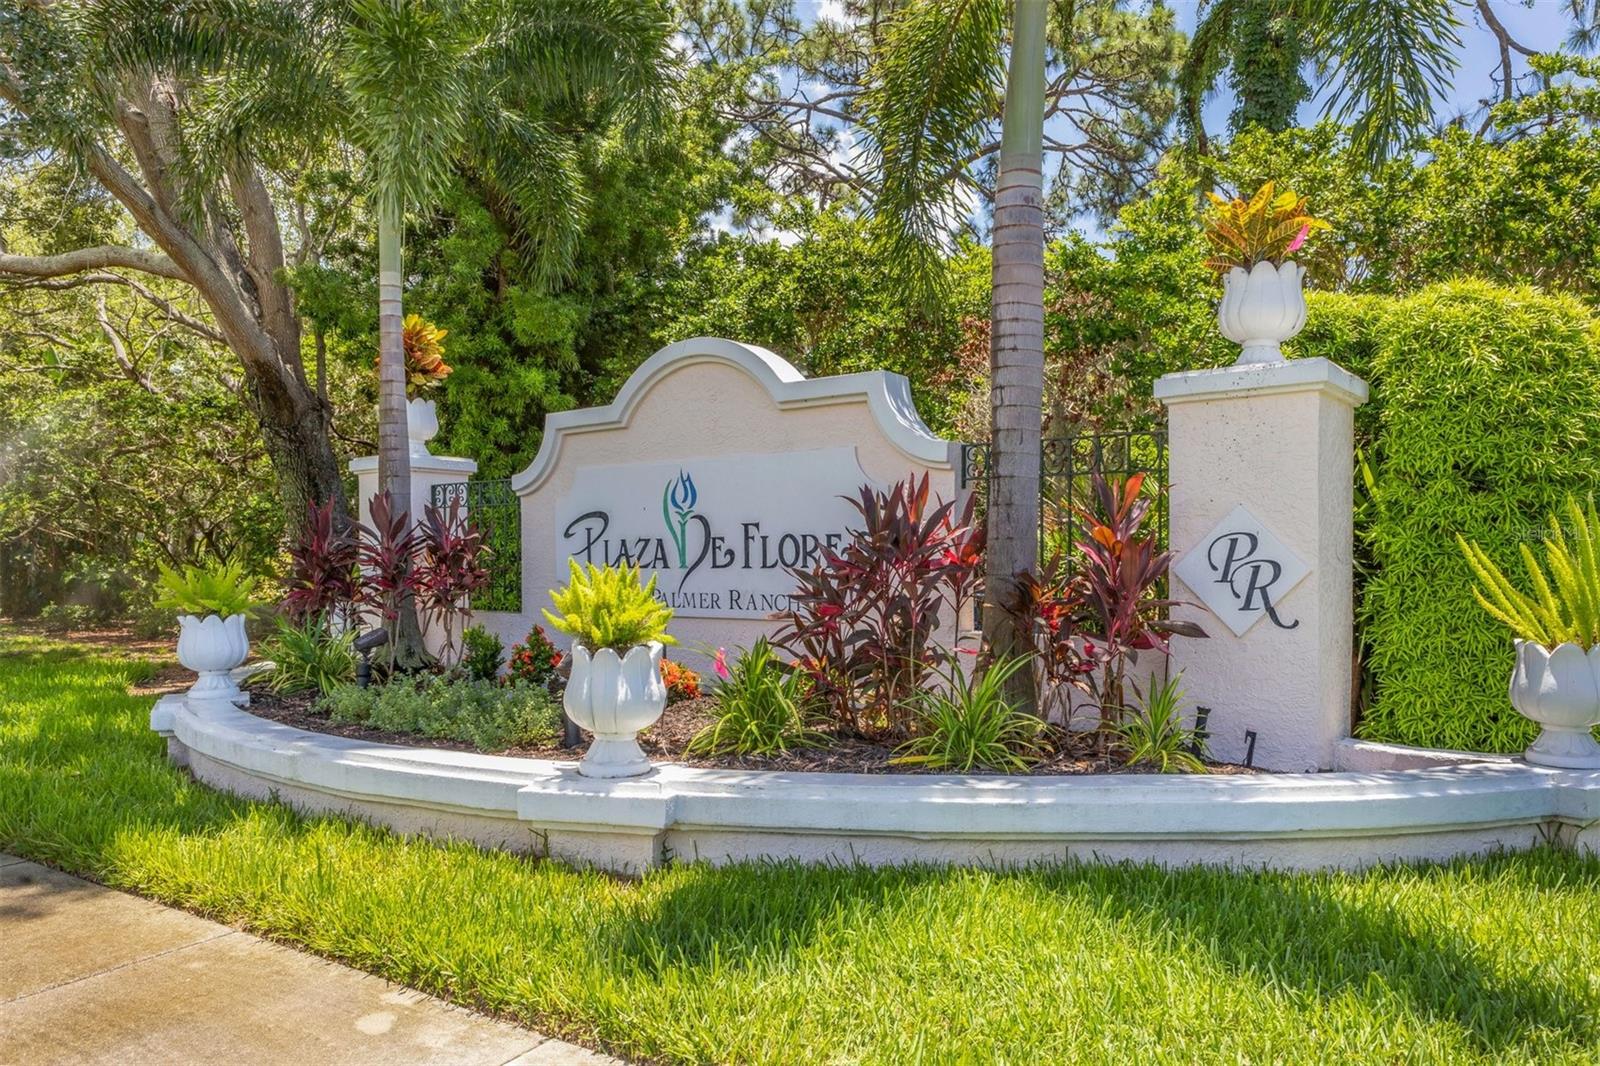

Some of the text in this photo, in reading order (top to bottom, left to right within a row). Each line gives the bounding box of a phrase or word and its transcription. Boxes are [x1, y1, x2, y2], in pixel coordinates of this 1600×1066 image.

[563, 510, 871, 598] PLAZA DE FLORE
